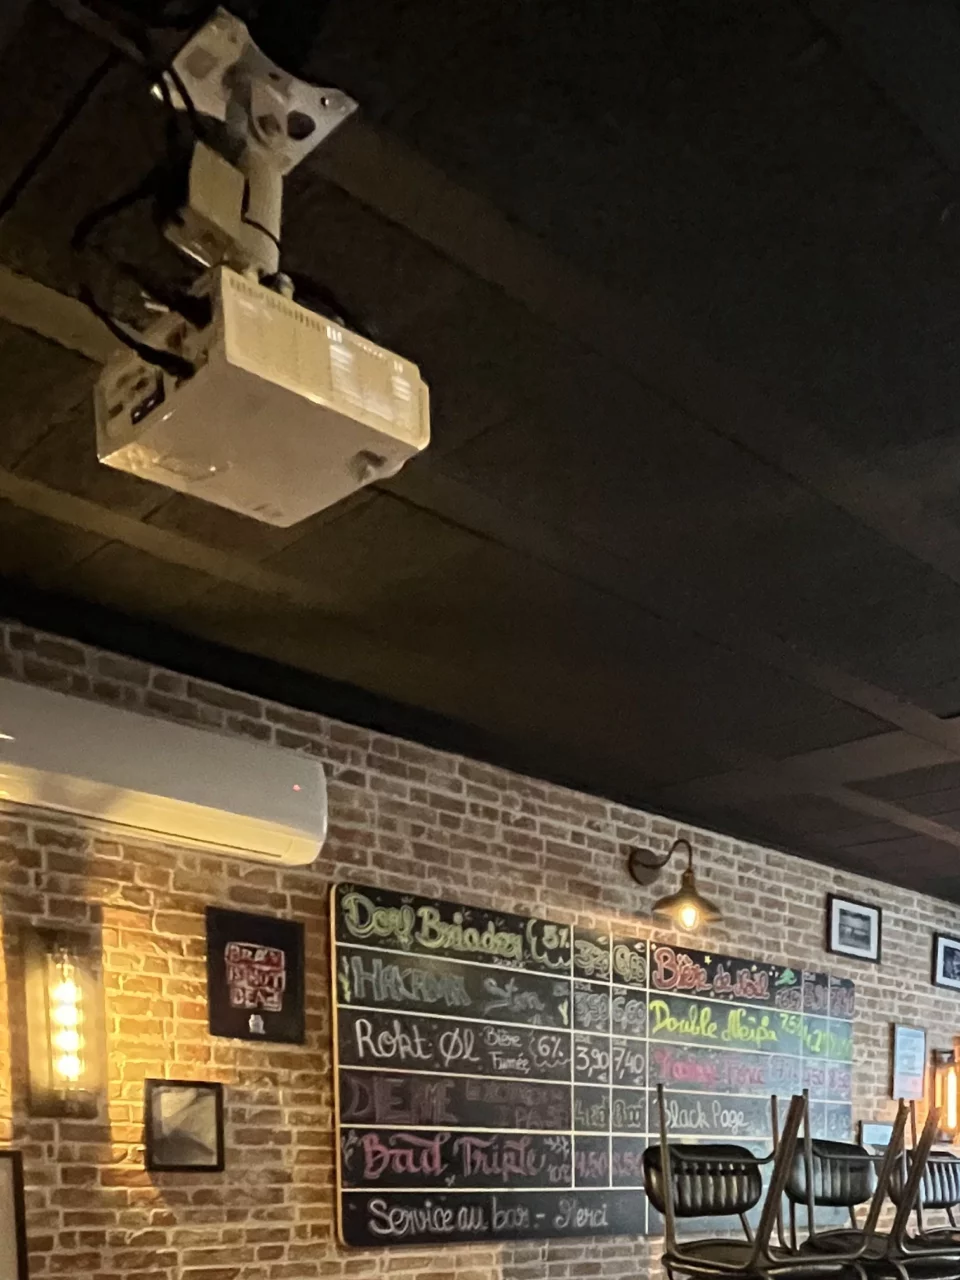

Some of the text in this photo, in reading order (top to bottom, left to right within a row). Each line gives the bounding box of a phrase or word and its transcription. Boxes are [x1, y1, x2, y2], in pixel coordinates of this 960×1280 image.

[650, 999, 718, 1037] Double
[575, 1046, 610, 1078] 3,90
[612, 1046, 646, 1079] 7,40
[712, 1099, 750, 1135] Page
[369, 1198, 452, 1236] Service
[458, 1206, 489, 1232] au
